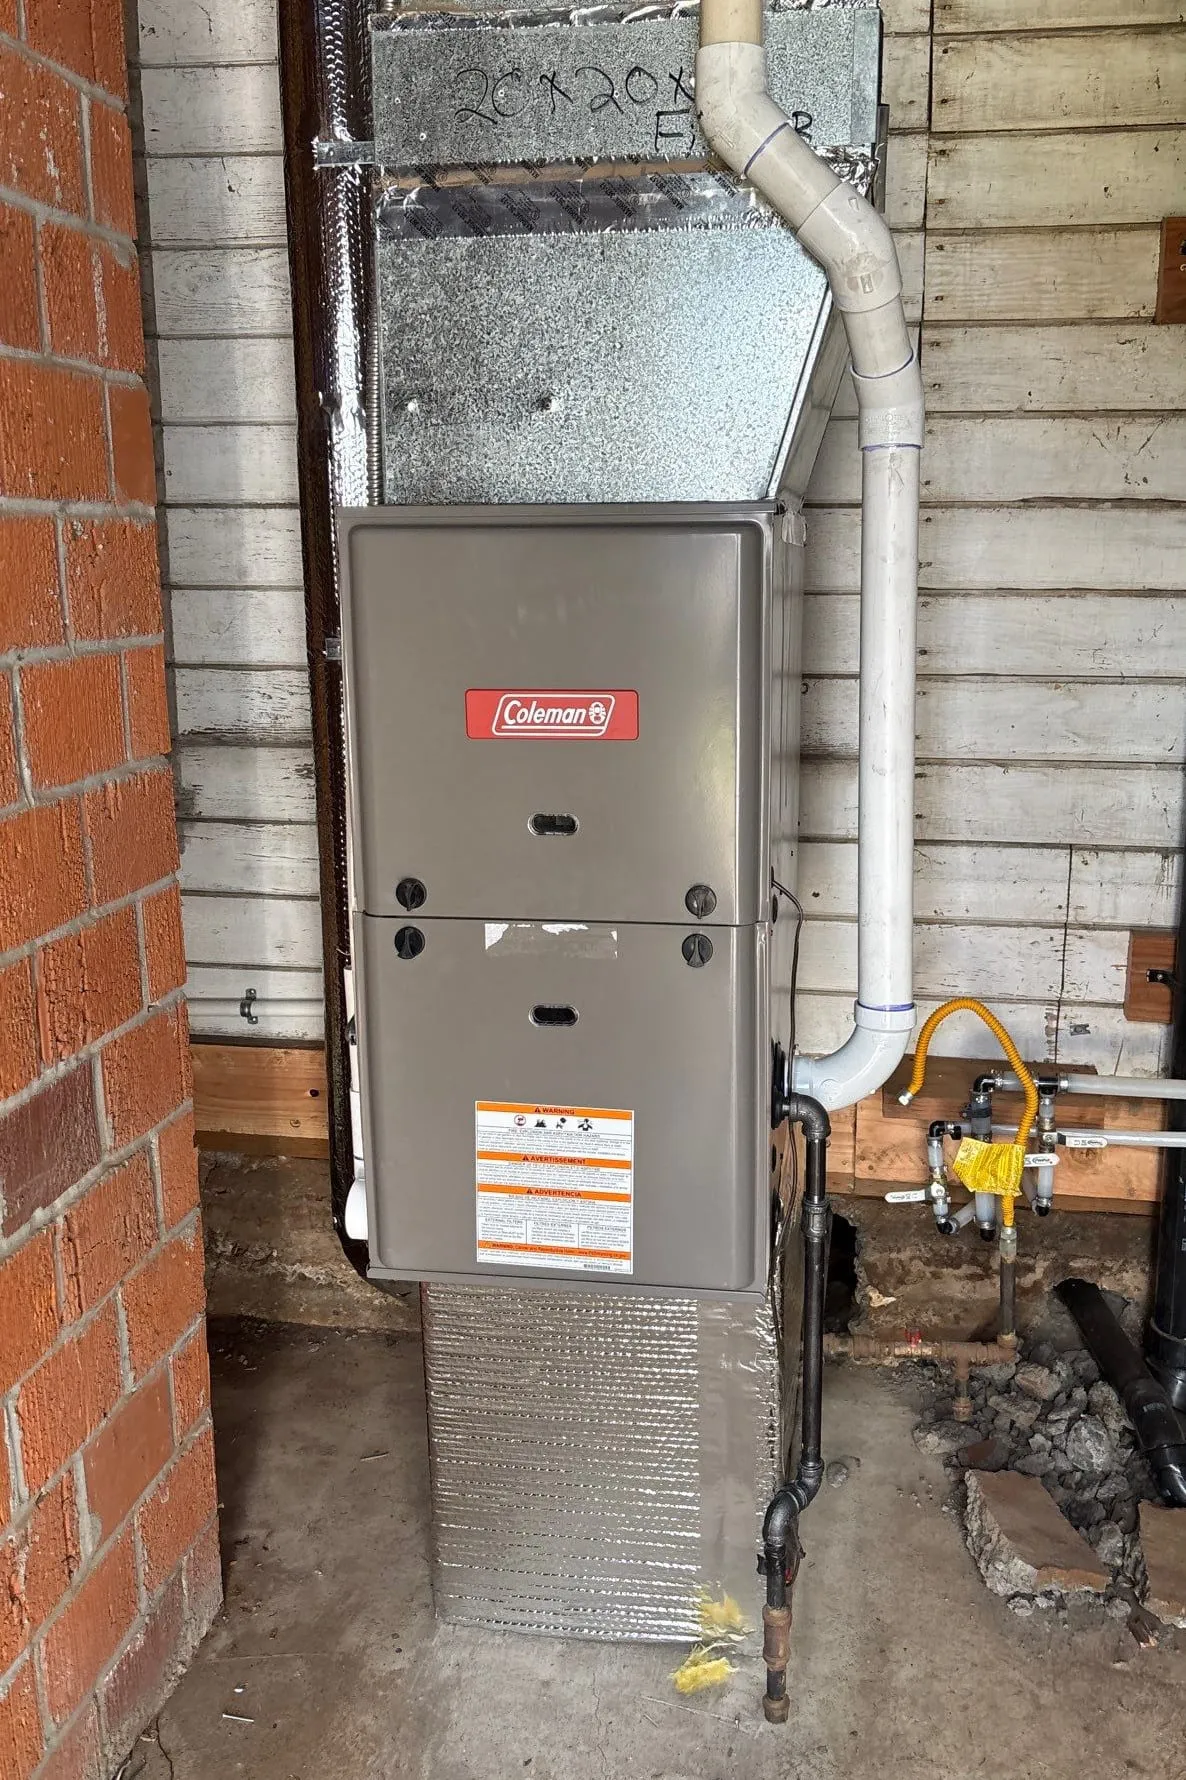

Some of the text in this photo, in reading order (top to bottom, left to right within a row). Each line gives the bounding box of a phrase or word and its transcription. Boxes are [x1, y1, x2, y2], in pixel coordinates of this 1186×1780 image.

[503, 700, 587, 725] Coleman
[543, 1107, 575, 1115] WARNING
[530, 1156, 586, 1164] AVERTISSEMENT
[534, 1189, 582, 1197] ADVERTENCIA
